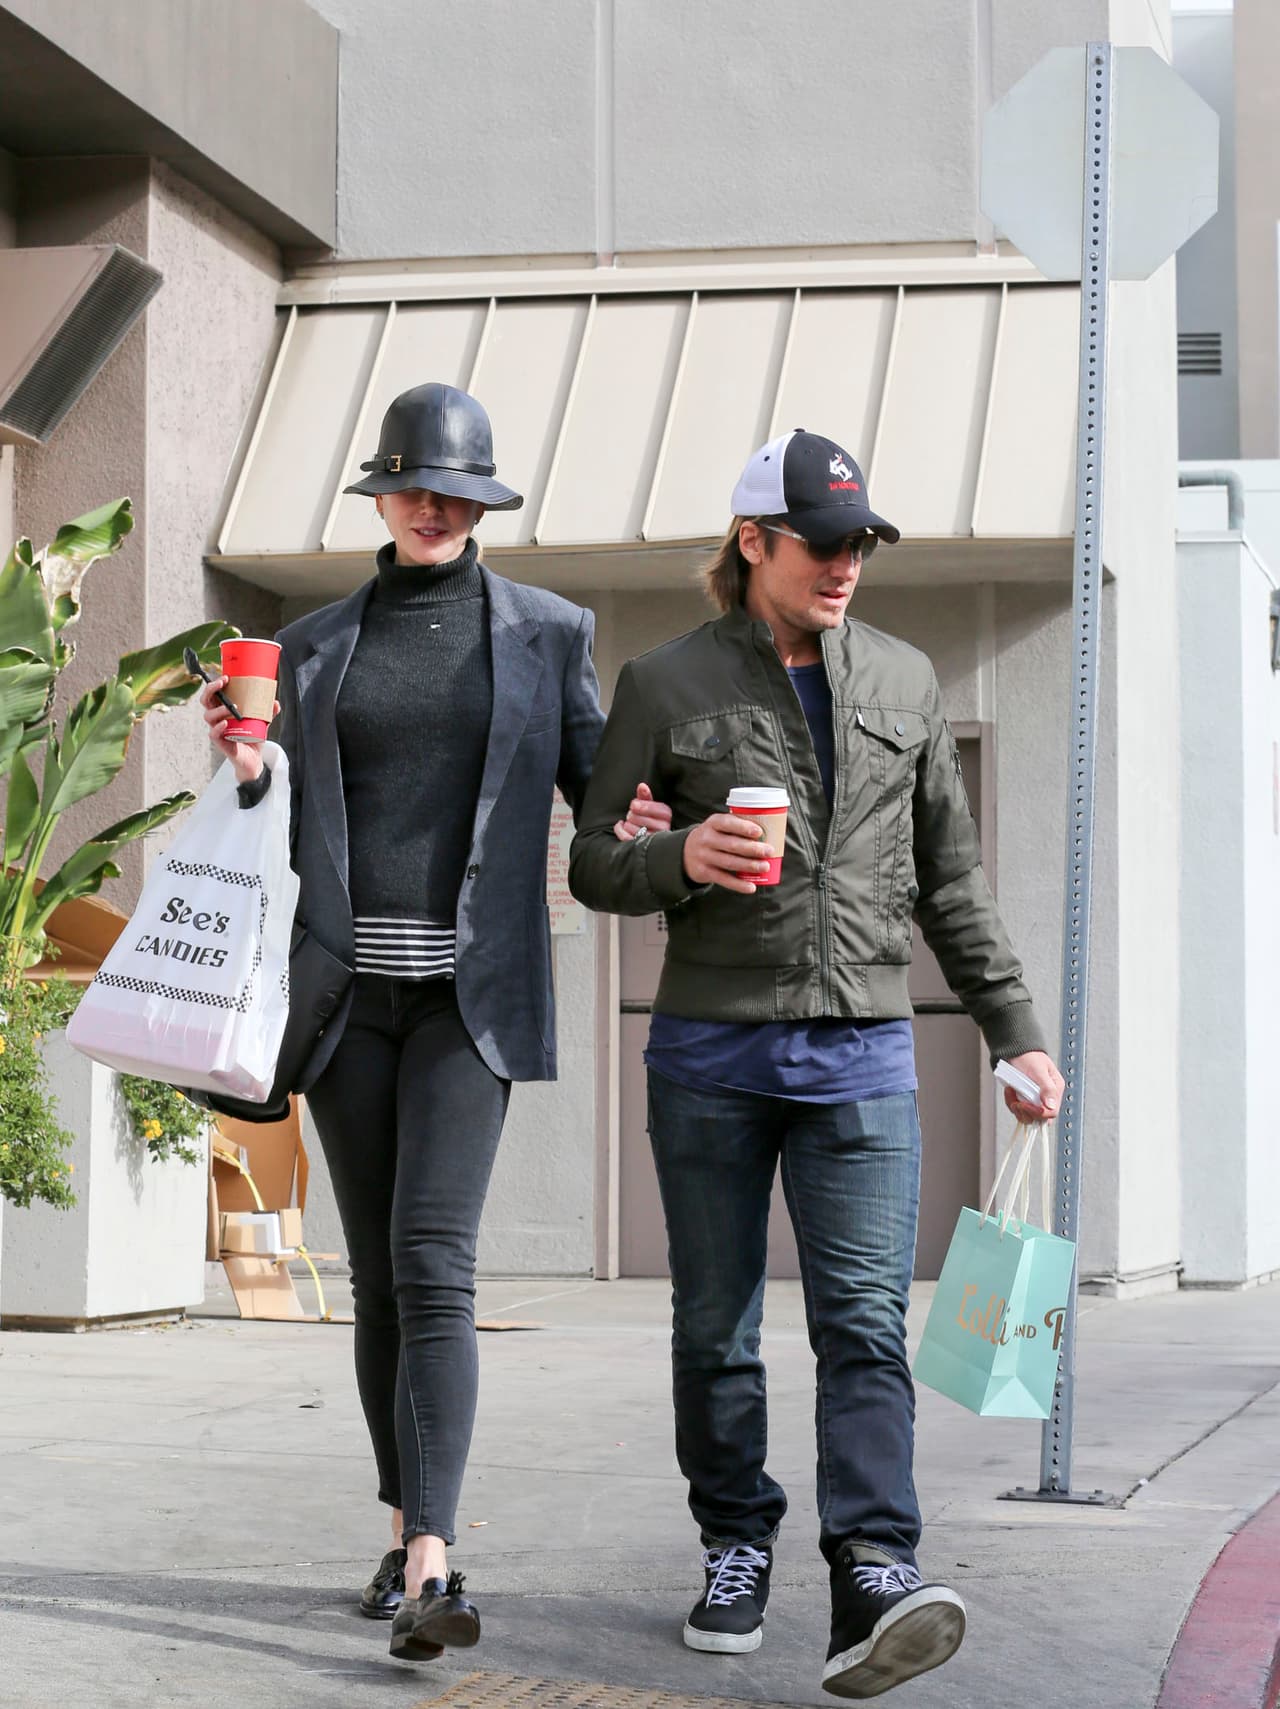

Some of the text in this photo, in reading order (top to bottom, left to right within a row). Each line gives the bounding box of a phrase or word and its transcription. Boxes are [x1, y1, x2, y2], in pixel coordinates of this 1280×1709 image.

[160, 897, 230, 934] See's
[135, 935, 228, 967] CANDIES
[1014, 1324, 1037, 1339] AND
